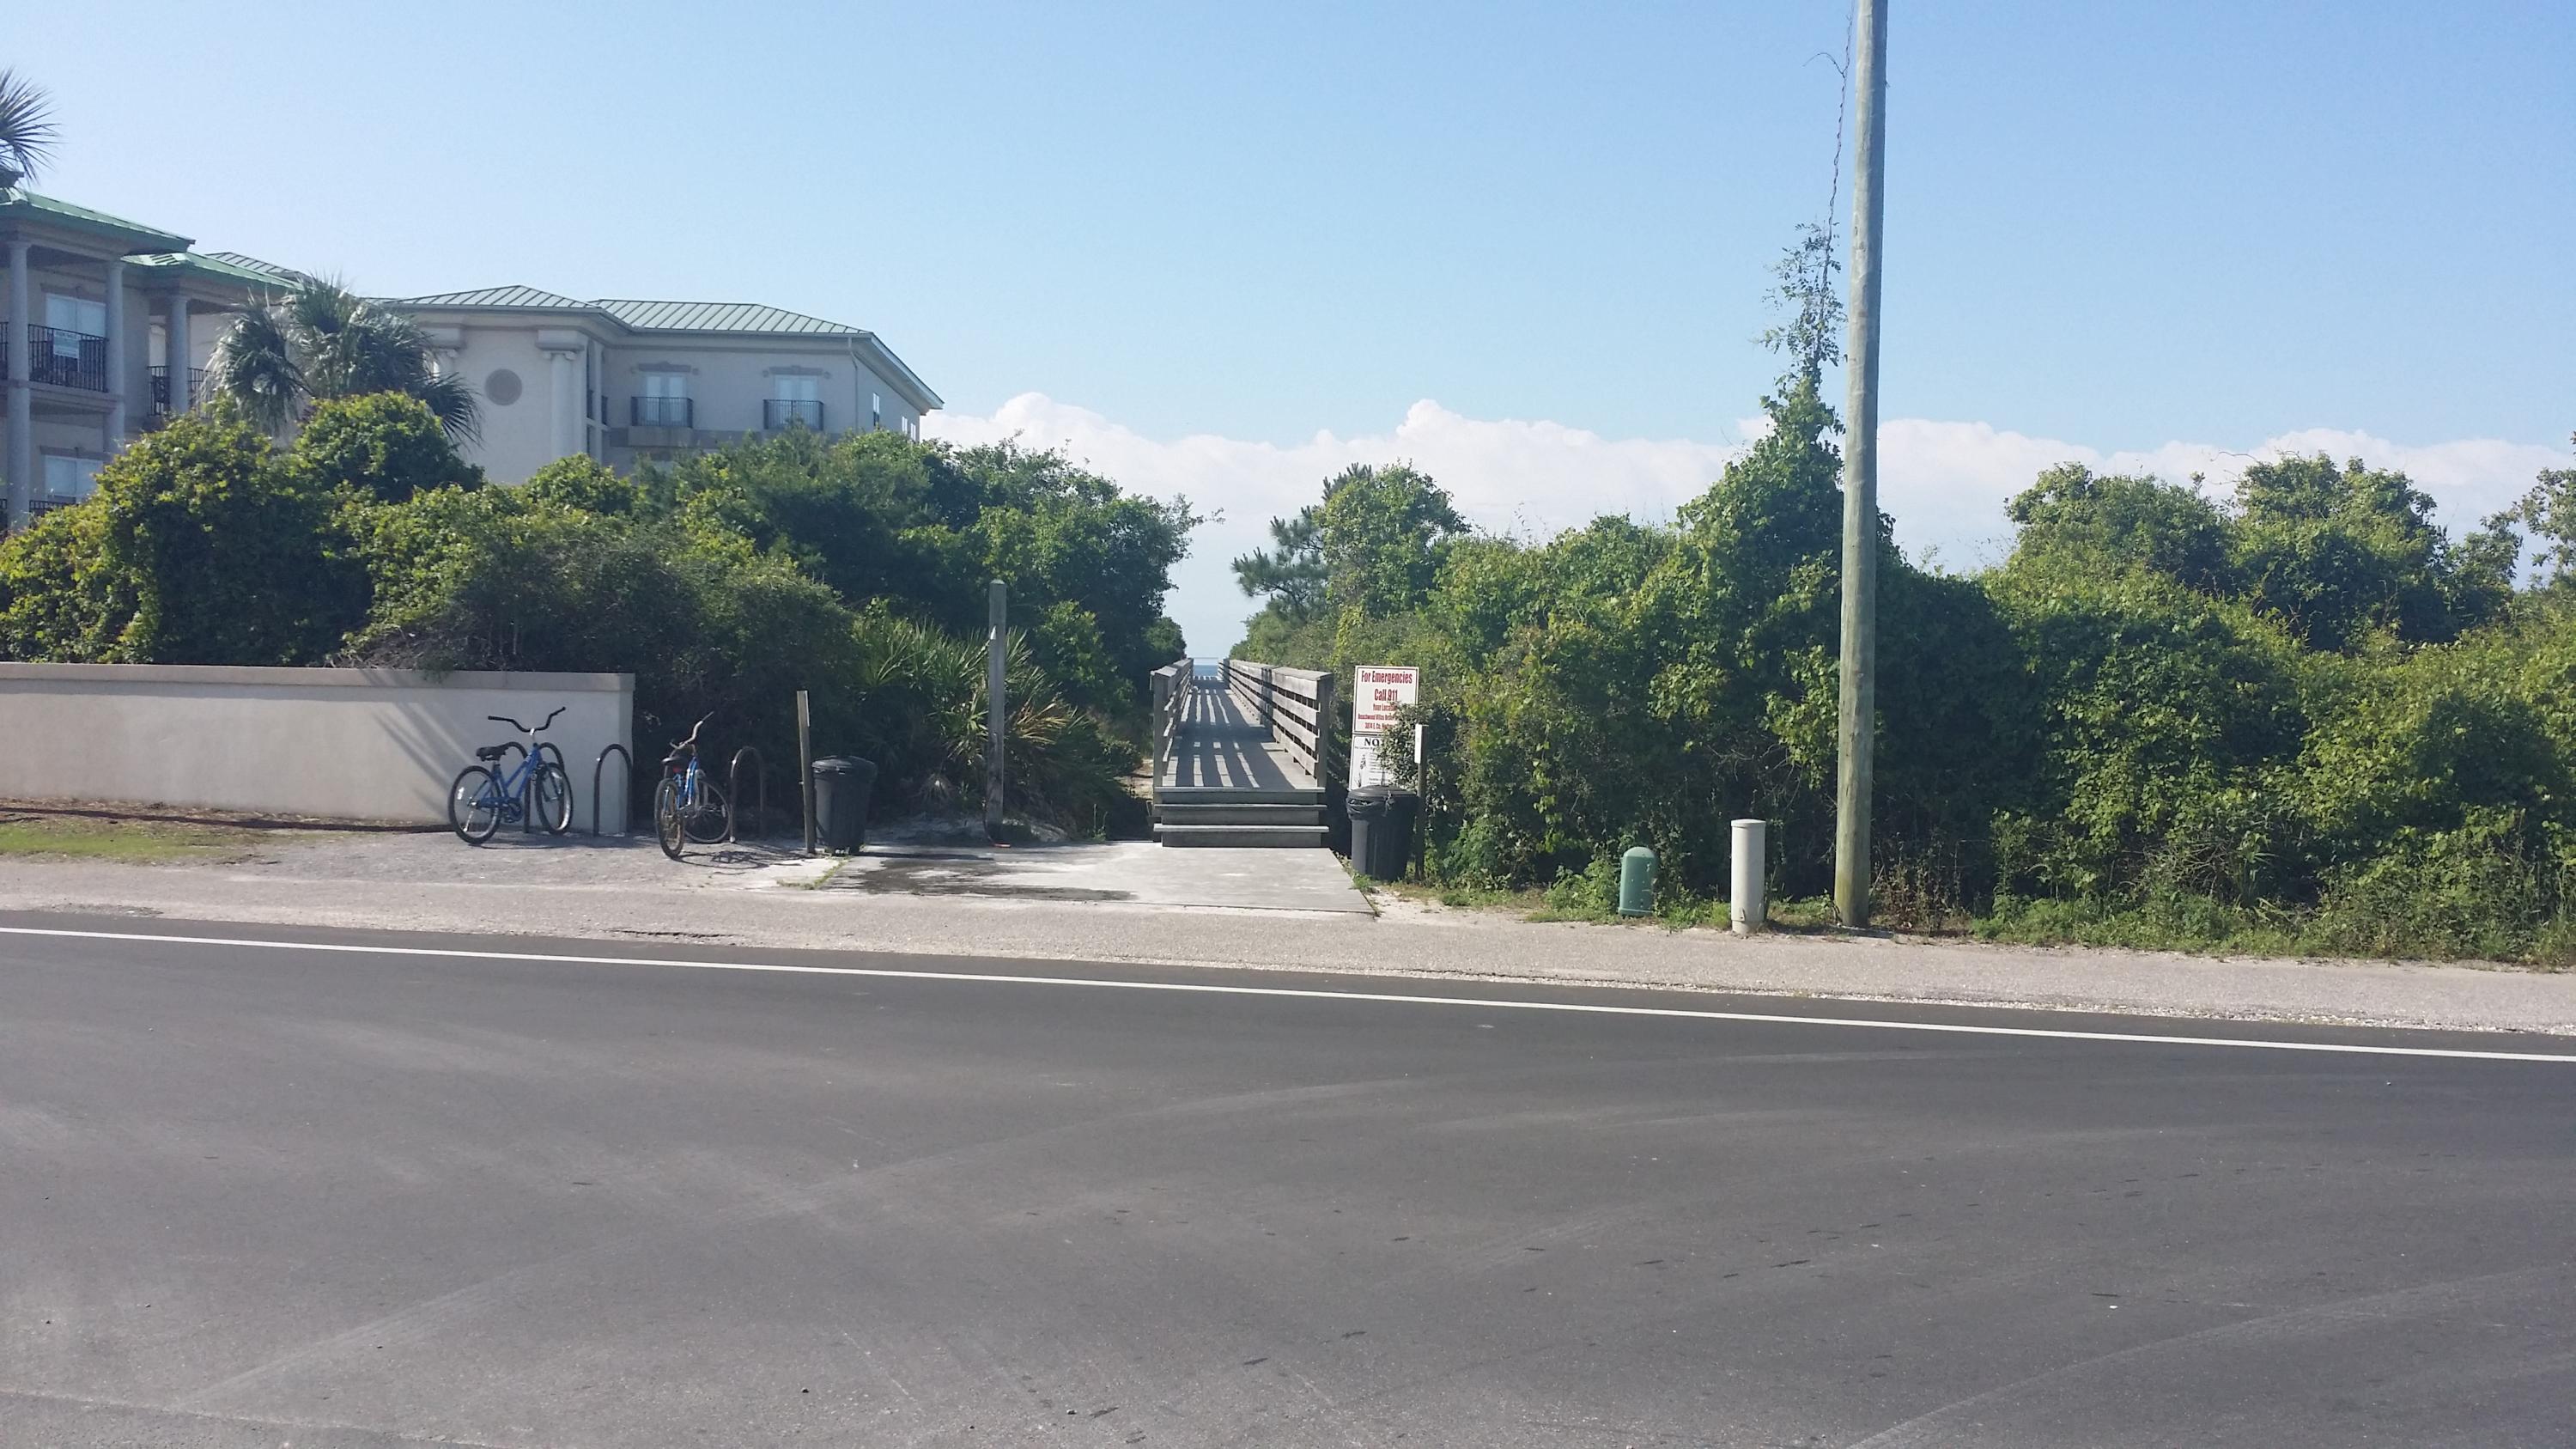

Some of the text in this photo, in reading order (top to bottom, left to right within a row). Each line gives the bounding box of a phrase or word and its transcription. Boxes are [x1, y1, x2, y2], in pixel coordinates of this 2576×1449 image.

[1362, 671, 1413, 684] For Emergencies
[1375, 689, 1398, 701] Call 911
